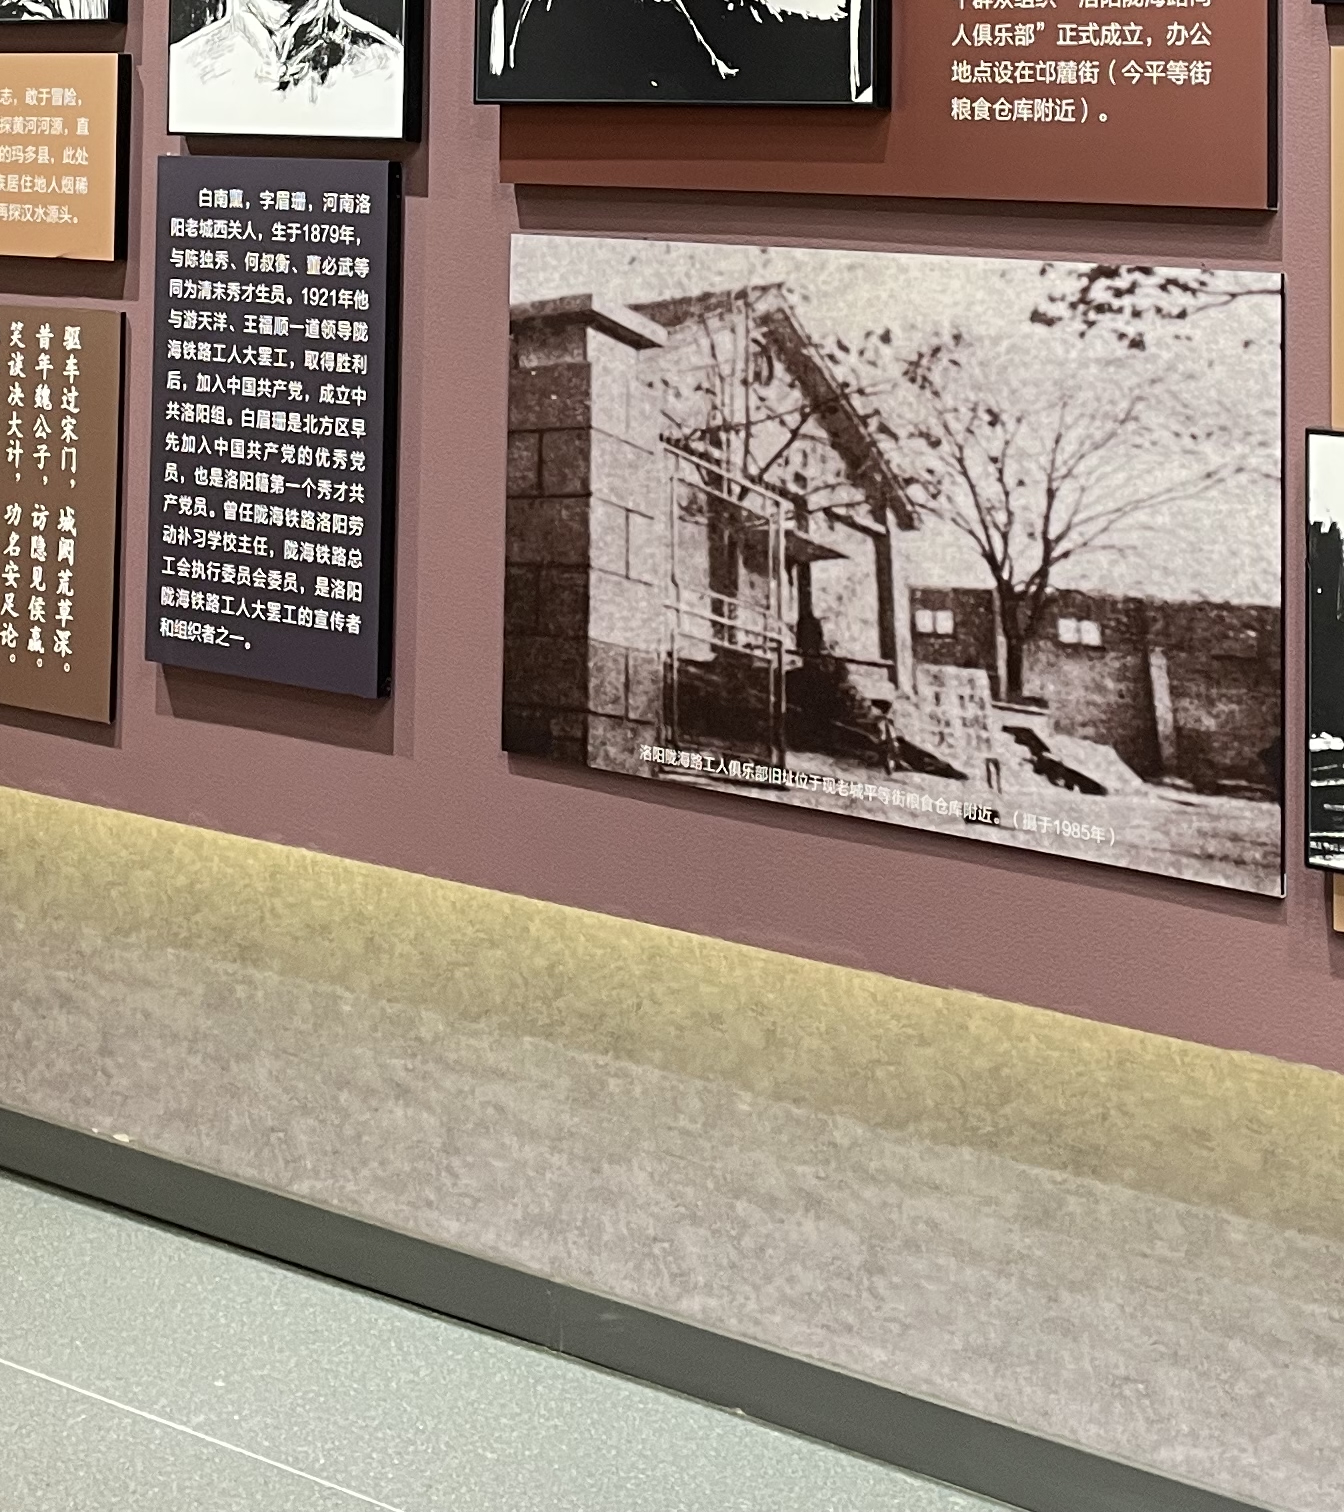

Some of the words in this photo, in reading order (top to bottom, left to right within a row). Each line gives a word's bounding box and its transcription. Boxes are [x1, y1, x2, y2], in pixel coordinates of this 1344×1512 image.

[170, 218, 363, 247] 阳老城西关人，生于1879年，
[170, 248, 371, 278] 与陈独秀、何叔衡、董必武等
[168, 309, 368, 344] 与游天洋、王福顺一道领导陇
[167, 340, 367, 375] 海铁路工人大罢工，取得胜利
[6, 320, 26, 482] 笑谈决大计，
[33, 322, 55, 485] 昔年魏公子，
[60, 325, 82, 489] 驱车过宋门，
[166, 371, 367, 407] 后，加入中国共产党，成立中
[165, 401, 366, 439] 共洛阳组。白眉珊是北方区早
[165, 432, 365, 471] 先加入中国共产党的优秀党
[164, 462, 364, 503] 员，也是洛阳籍第一个秀才共
[163, 493, 364, 537] 产党员。曾任陇海铁路洛阳劳
[162, 524, 363, 569] 动补习学校主任，陇海铁路总
[0, 503, 22, 663] 功名安足论。
[161, 555, 362, 604] 工会执行委员会委员，是洛阳
[160, 586, 361, 635] 陇海铁路工人大罢工的宣传者
[160, 617, 252, 651] 和组织者之一。
